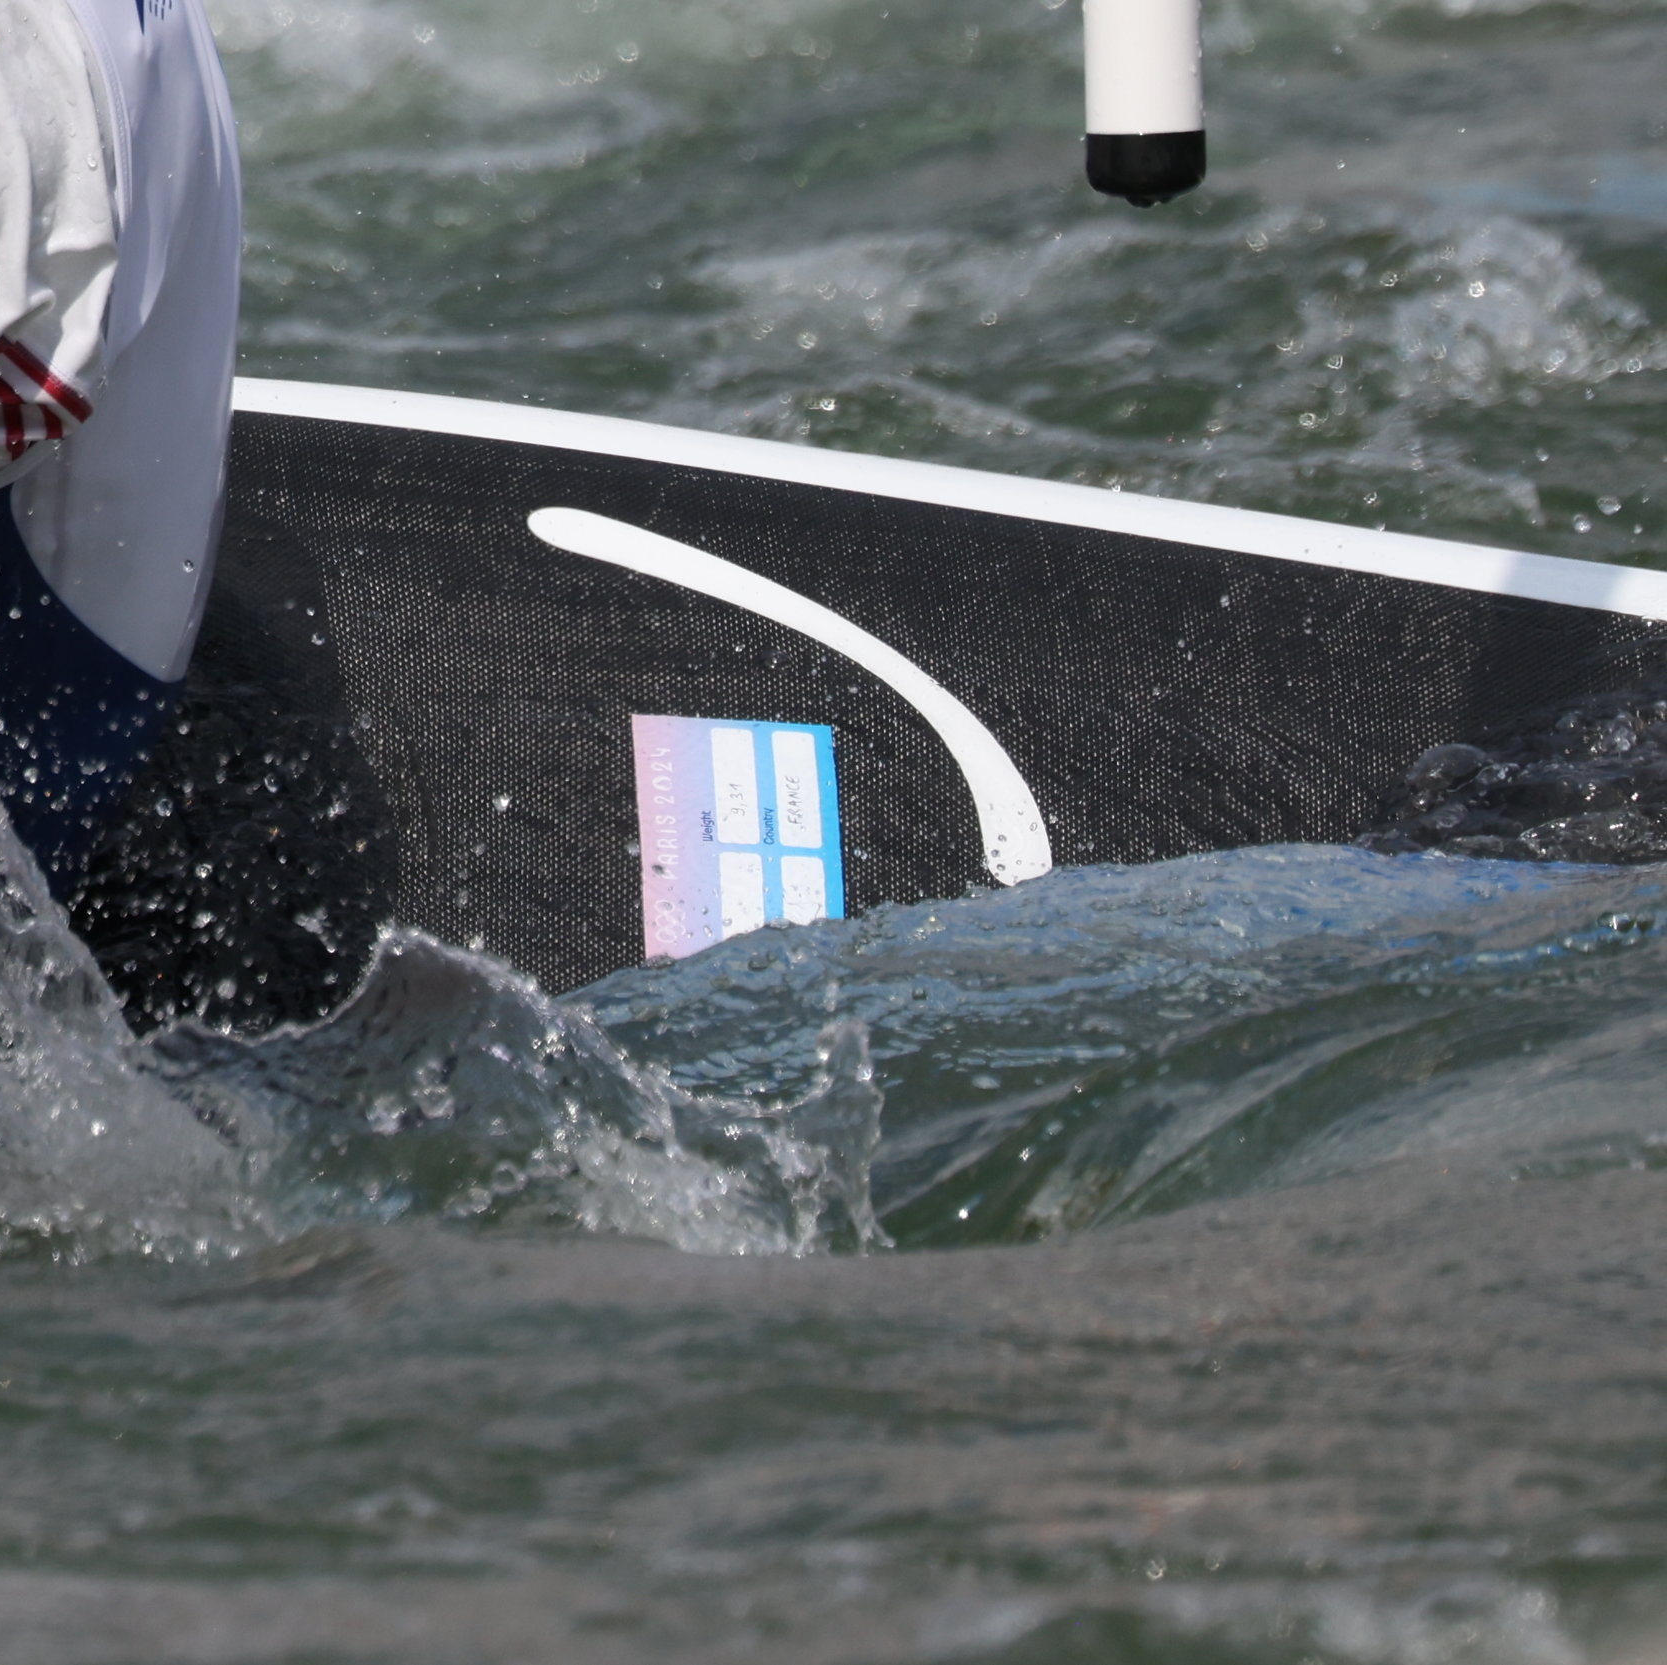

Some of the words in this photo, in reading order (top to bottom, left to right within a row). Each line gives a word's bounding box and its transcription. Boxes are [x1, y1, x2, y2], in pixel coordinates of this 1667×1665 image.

[651, 747, 675, 804] 2024
[785, 775, 803, 825] FRANCE
[700, 810, 715, 842] Weight
[763, 808, 775, 845] Country
